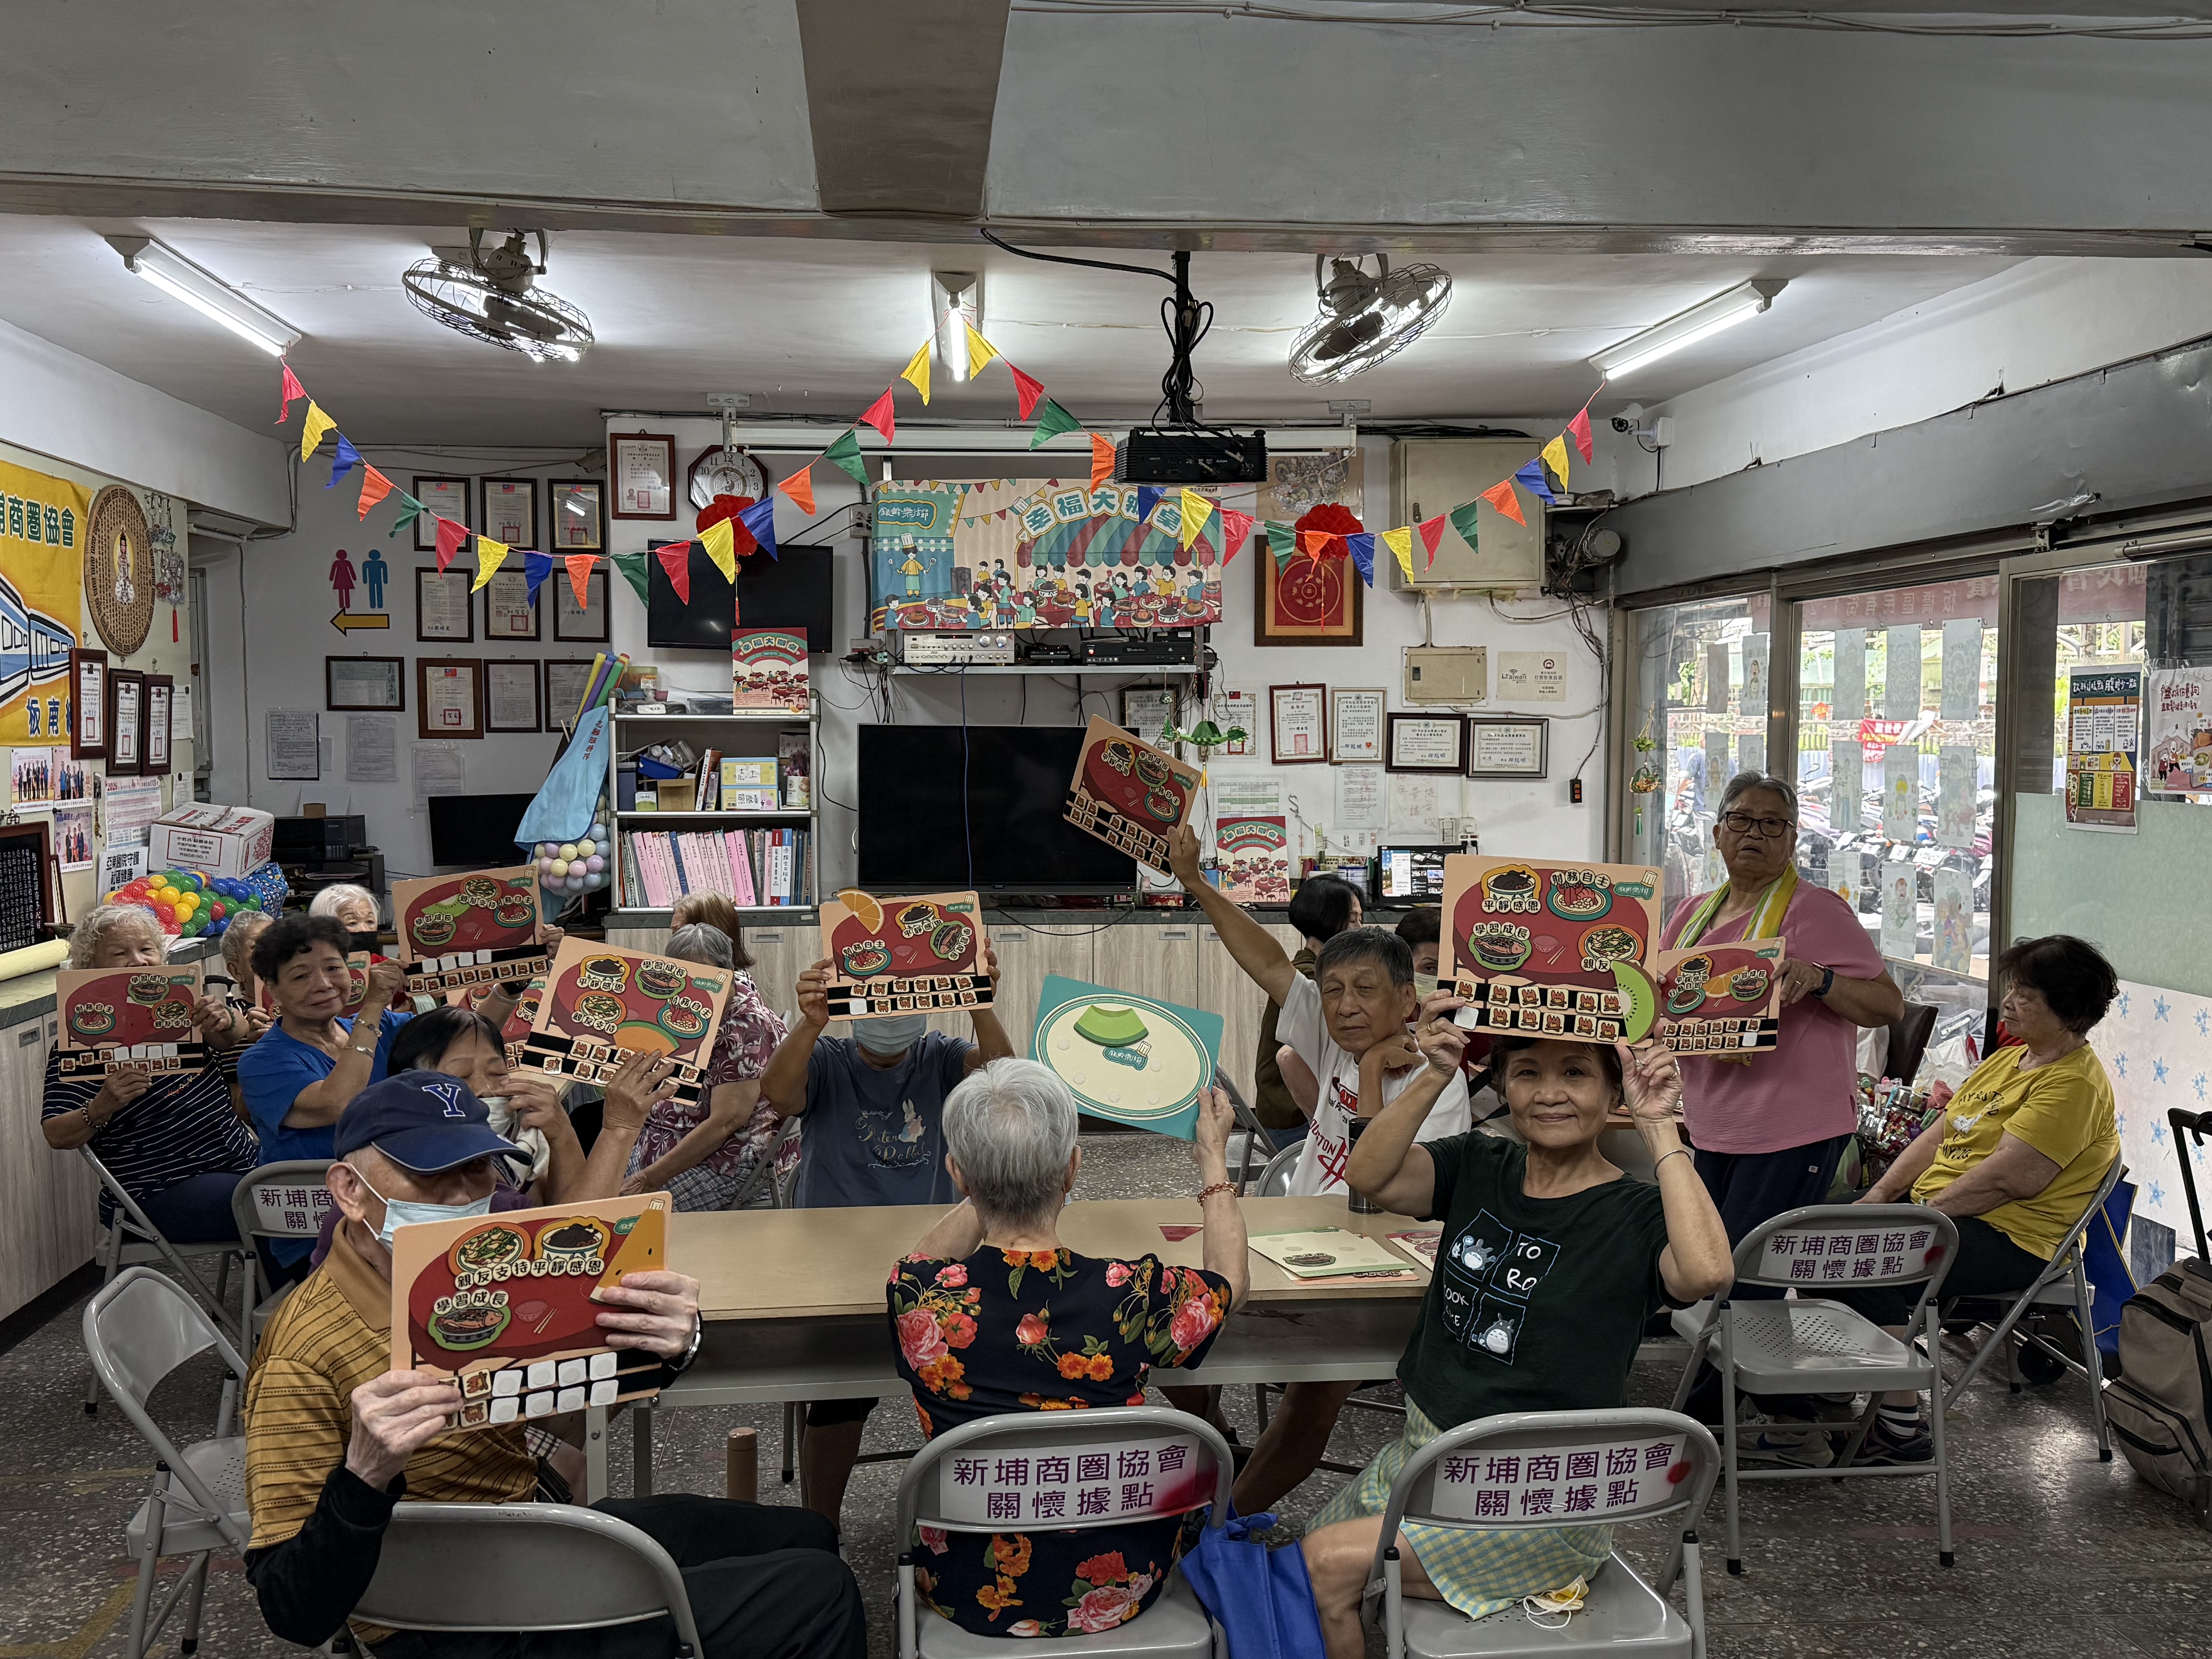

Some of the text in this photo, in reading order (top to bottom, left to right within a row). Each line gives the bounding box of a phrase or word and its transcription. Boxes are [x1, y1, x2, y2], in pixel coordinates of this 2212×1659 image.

[750, 468, 755, 476] 2
[878, 506, 929, 520] 銀齡樂活節
[738, 768, 757, 780] 志工
[111, 868, 133, 885] 社區健康
[1551, 871, 1609, 887] 財務自主
[1483, 900, 1540, 912] 平靜感恩
[1474, 922, 1530, 939] 學習成長
[642, 960, 687, 977] 學習成長
[577, 977, 625, 992] 平靜感恩
[572, 1012, 617, 1034] 親友支持
[422, 1083, 466, 1118] Y
[1516, 1240, 1542, 1260] TO
[1771, 1230, 1931, 1256] 新埔商圈協會
[457, 1259, 603, 1288] 親友支持 平靜感恩
[1790, 1255, 1905, 1279] 關懷據點
[1506, 1268, 1537, 1291] RO
[436, 1290, 508, 1314] 學習成長
[953, 1444, 1189, 1486] 新埔商圈協會
[1444, 1443, 1675, 1484] 新埔商圈協會
[987, 1481, 1154, 1519] 關懷據點
[1475, 1479, 1640, 1517] 關懷據點
